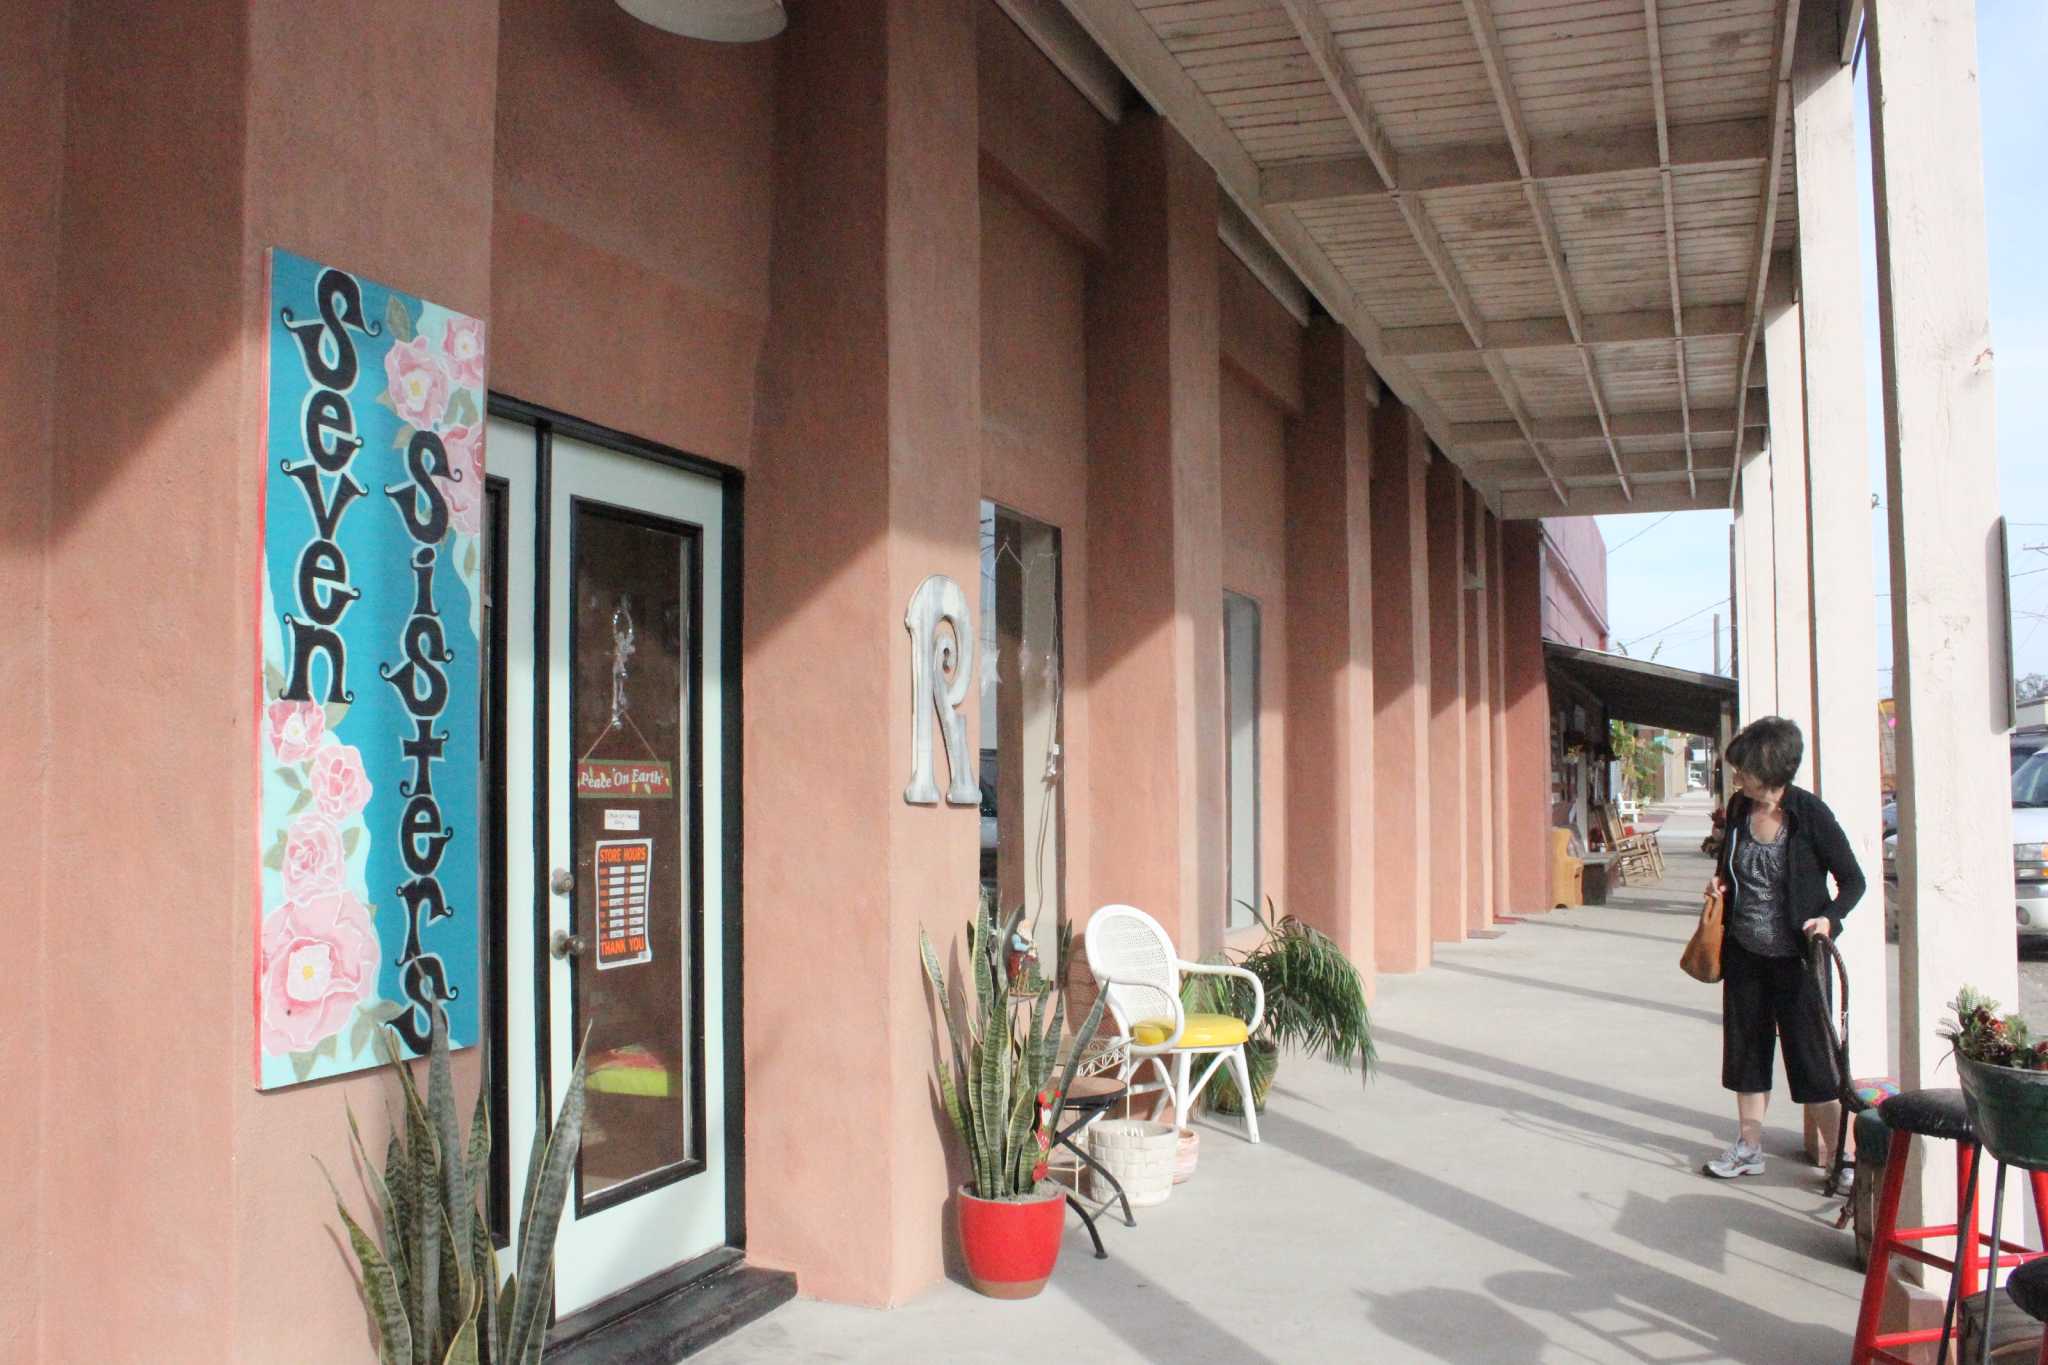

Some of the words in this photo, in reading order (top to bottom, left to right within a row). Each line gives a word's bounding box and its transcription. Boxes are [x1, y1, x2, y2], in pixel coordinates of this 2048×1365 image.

[280, 267, 382, 704] Seven
[581, 770, 612, 788] Peace
[631, 768, 661, 784] Earth
[600, 847, 621, 863] STORE
[624, 846, 646, 861] HOURS
[601, 939, 625, 956] THANK
[629, 935, 645, 951] YOU
